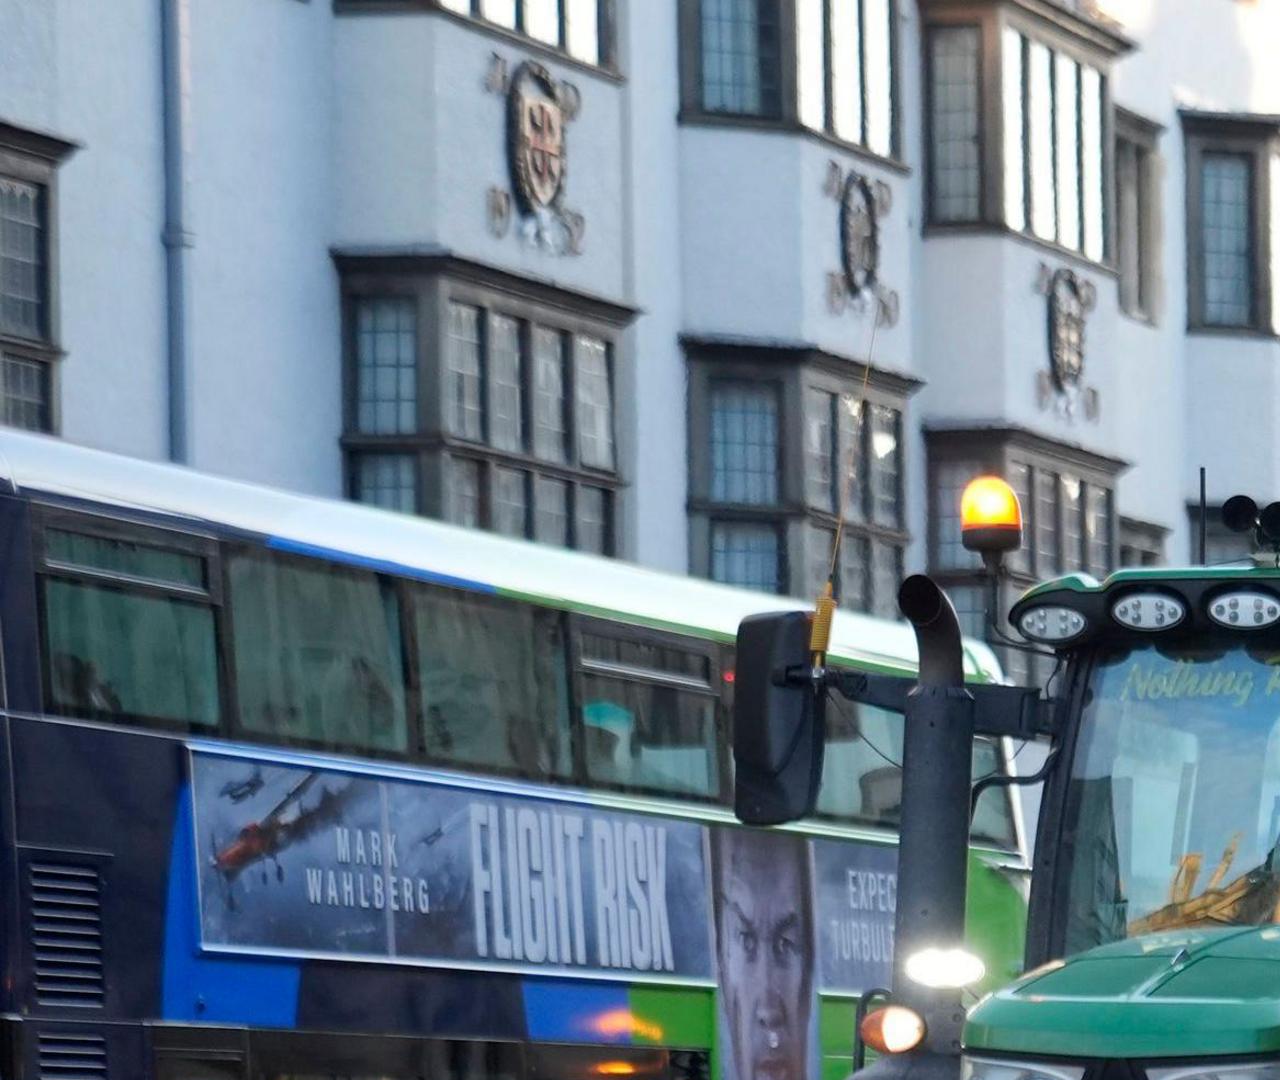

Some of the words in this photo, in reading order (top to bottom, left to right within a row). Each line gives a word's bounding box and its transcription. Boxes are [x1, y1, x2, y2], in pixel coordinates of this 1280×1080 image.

[1120, 658, 1253, 708] Nothing
[335, 826, 399, 868] MARK
[306, 868, 430, 914] WAHLBERG
[469, 803, 586, 966] FLIGHT
[593, 819, 675, 972] RISK
[848, 870, 897, 913] EXPEC
